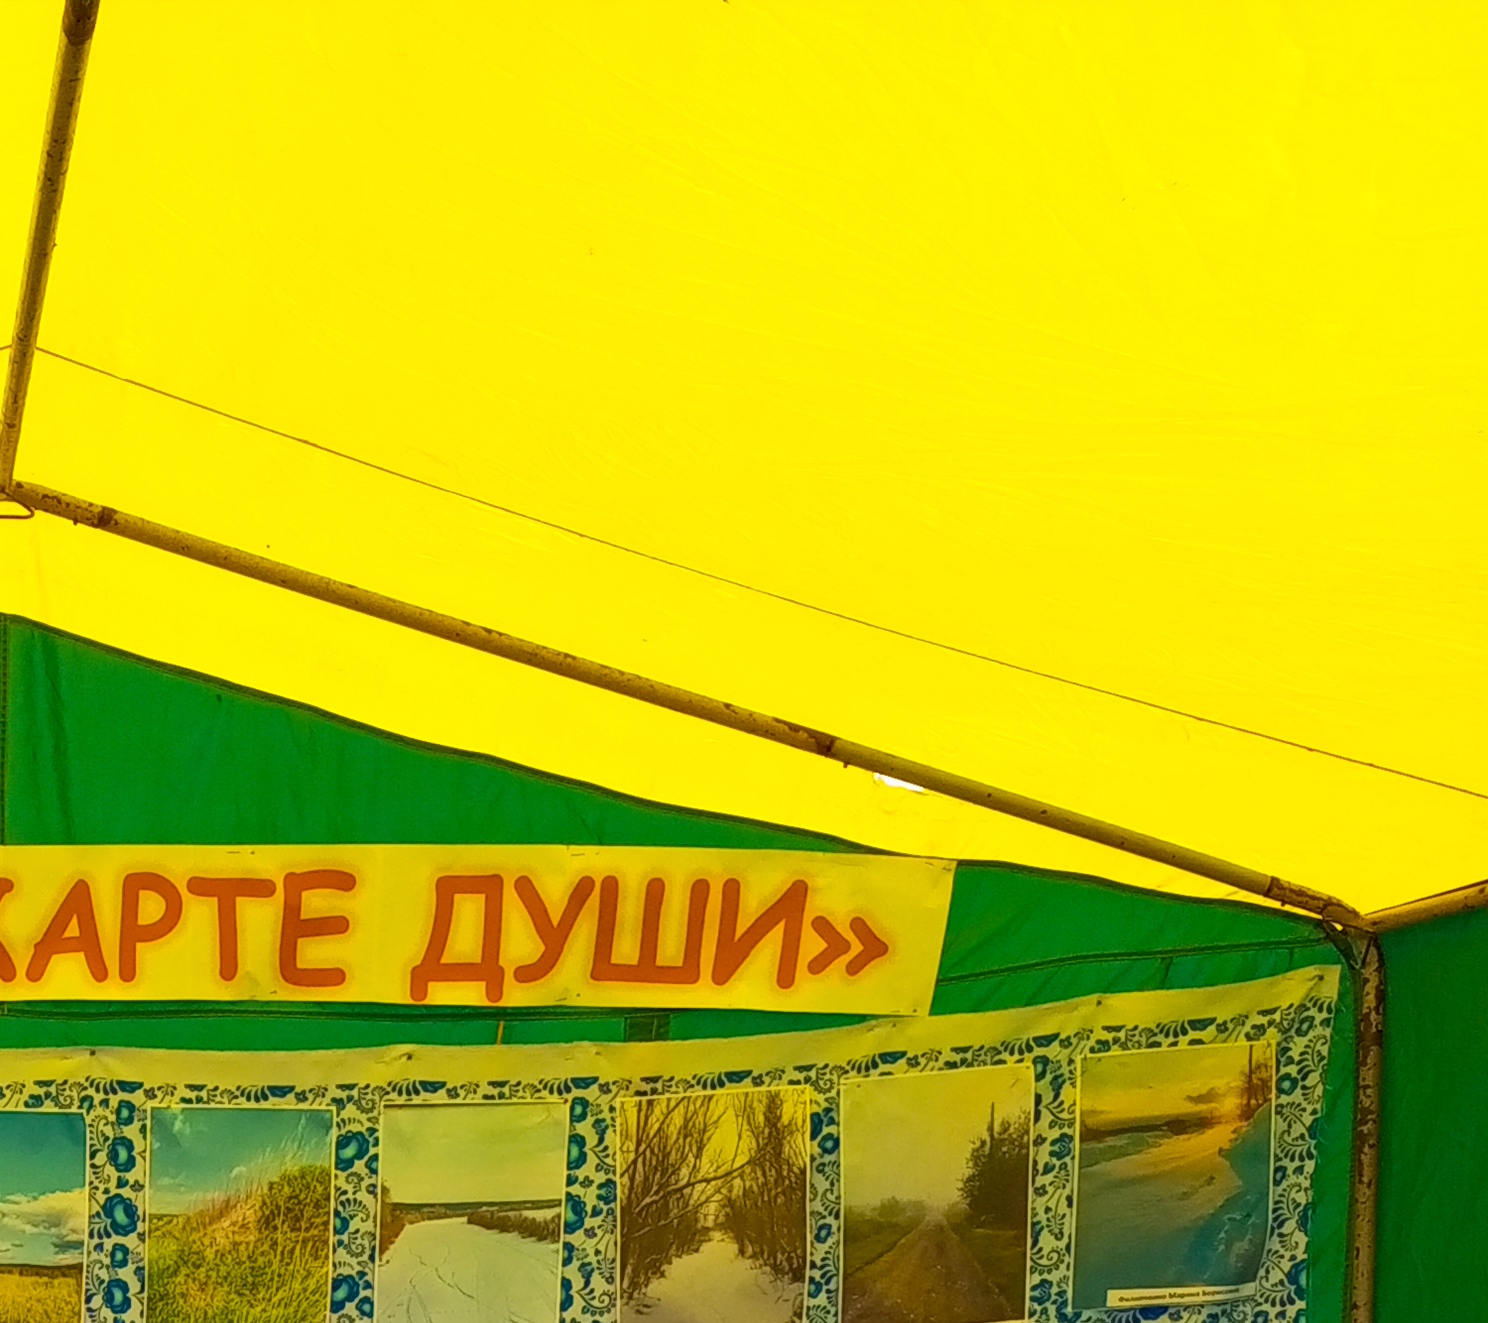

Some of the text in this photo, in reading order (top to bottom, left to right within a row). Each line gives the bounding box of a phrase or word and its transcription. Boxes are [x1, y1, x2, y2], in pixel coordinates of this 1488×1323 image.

[409, 873, 888, 1002] ДУШИ»
[1169, 1291, 1200, 1300] Марина
[1202, 1287, 1239, 1297] Борисовна
